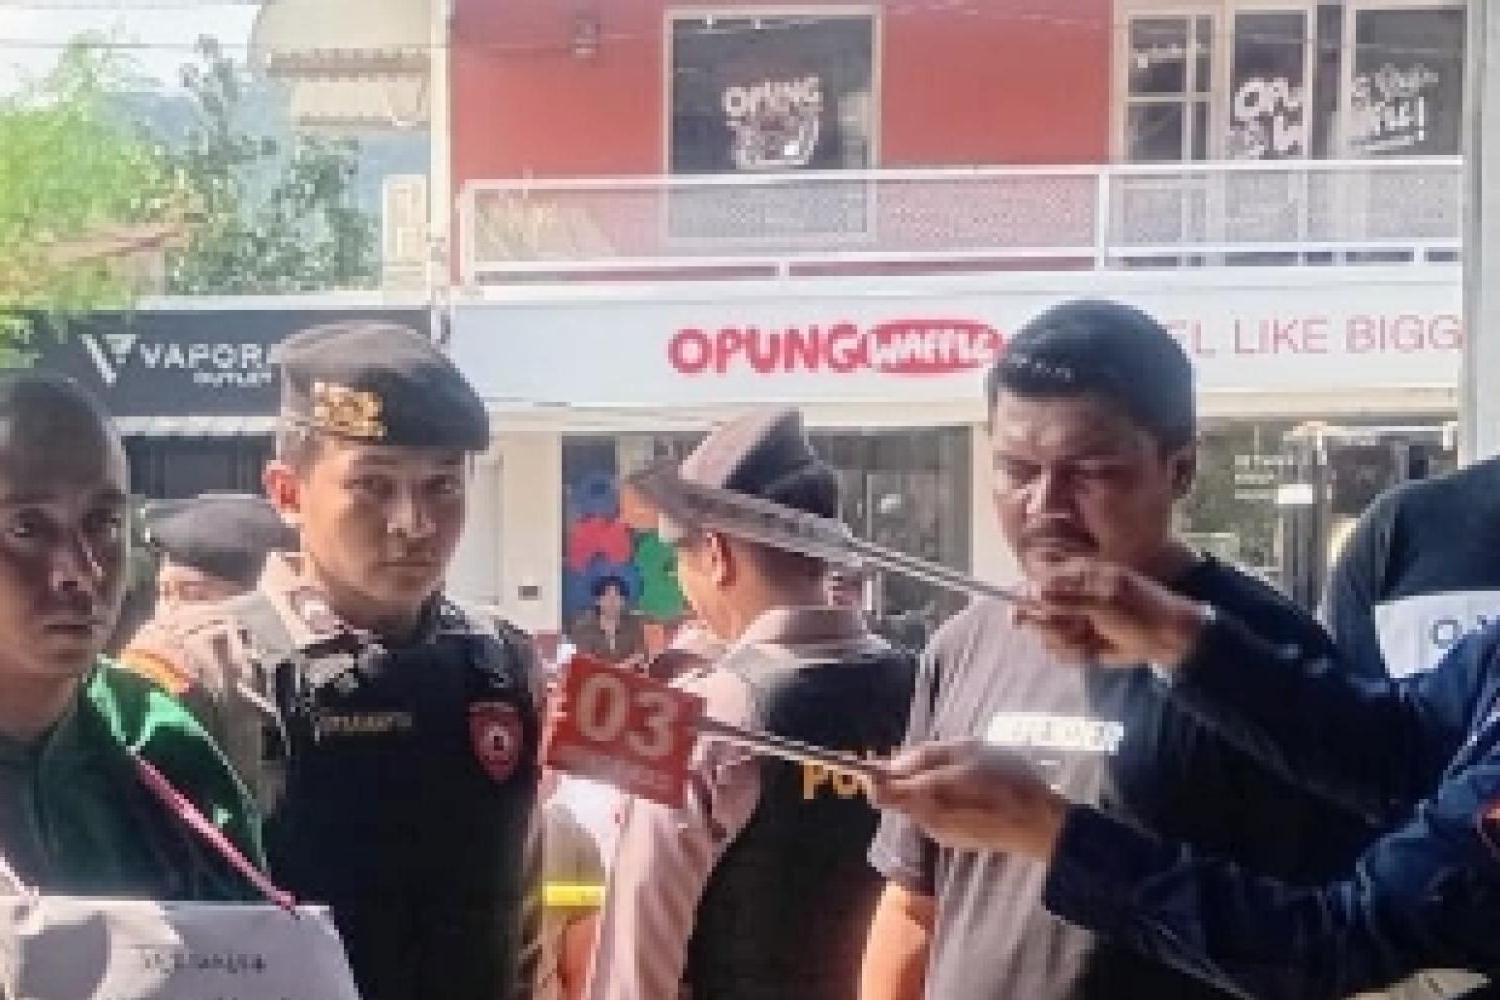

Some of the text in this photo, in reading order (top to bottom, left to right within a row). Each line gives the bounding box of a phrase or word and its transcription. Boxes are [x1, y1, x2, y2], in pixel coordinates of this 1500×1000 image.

[668, 324, 868, 374] OPUNG
[1234, 317, 1328, 355] LIKE
[1344, 313, 1464, 354] BIGG
[575, 672, 679, 757] 03
